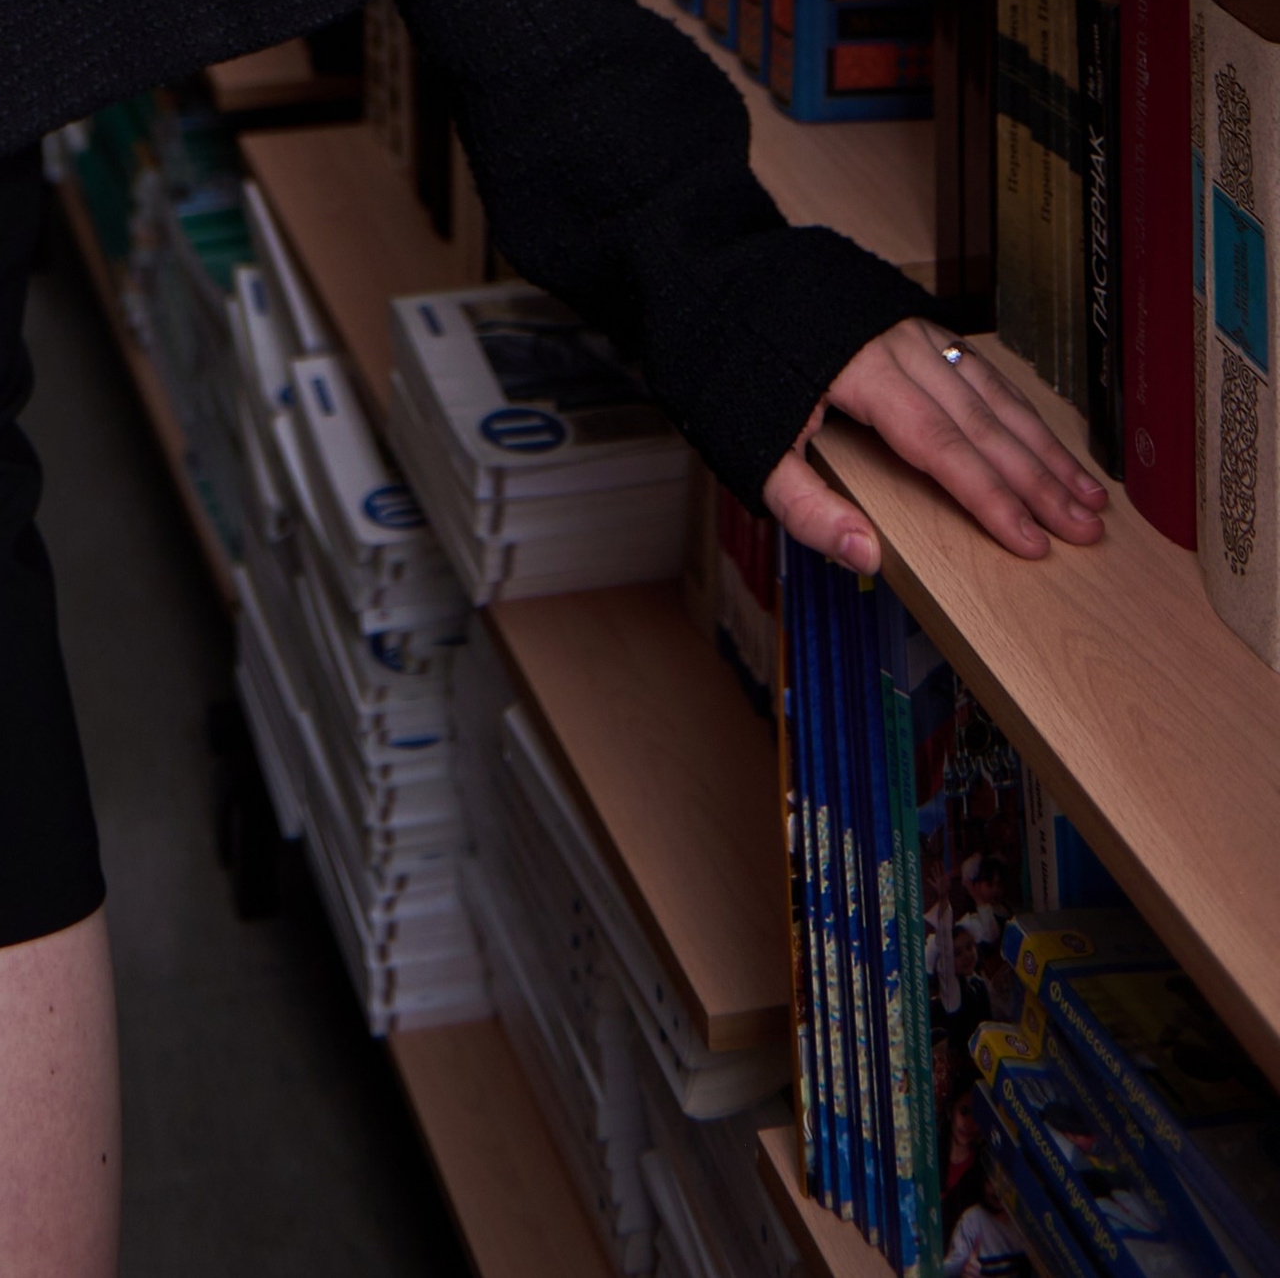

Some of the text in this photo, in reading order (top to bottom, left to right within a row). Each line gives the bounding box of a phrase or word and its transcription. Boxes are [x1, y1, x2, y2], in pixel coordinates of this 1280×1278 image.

[1089, 122, 1109, 339] ПАСТЕРНАК
[893, 829, 906, 901] ОСНОВЫ
[907, 850, 920, 923] ОСНОВЫ
[898, 912, 915, 1048] ПРАВОСЛАВНОЙ
[912, 934, 929, 1072] ПРАВОСЛАВНОЙ
[922, 1080, 934, 1169] КУЛЬТУРЫ
[1048, 980, 1122, 1079] Физическая
[1122, 1073, 1182, 1153] культура
[1001, 1078, 1067, 1183] Физическая
[1064, 1177, 1118, 1262] культура
